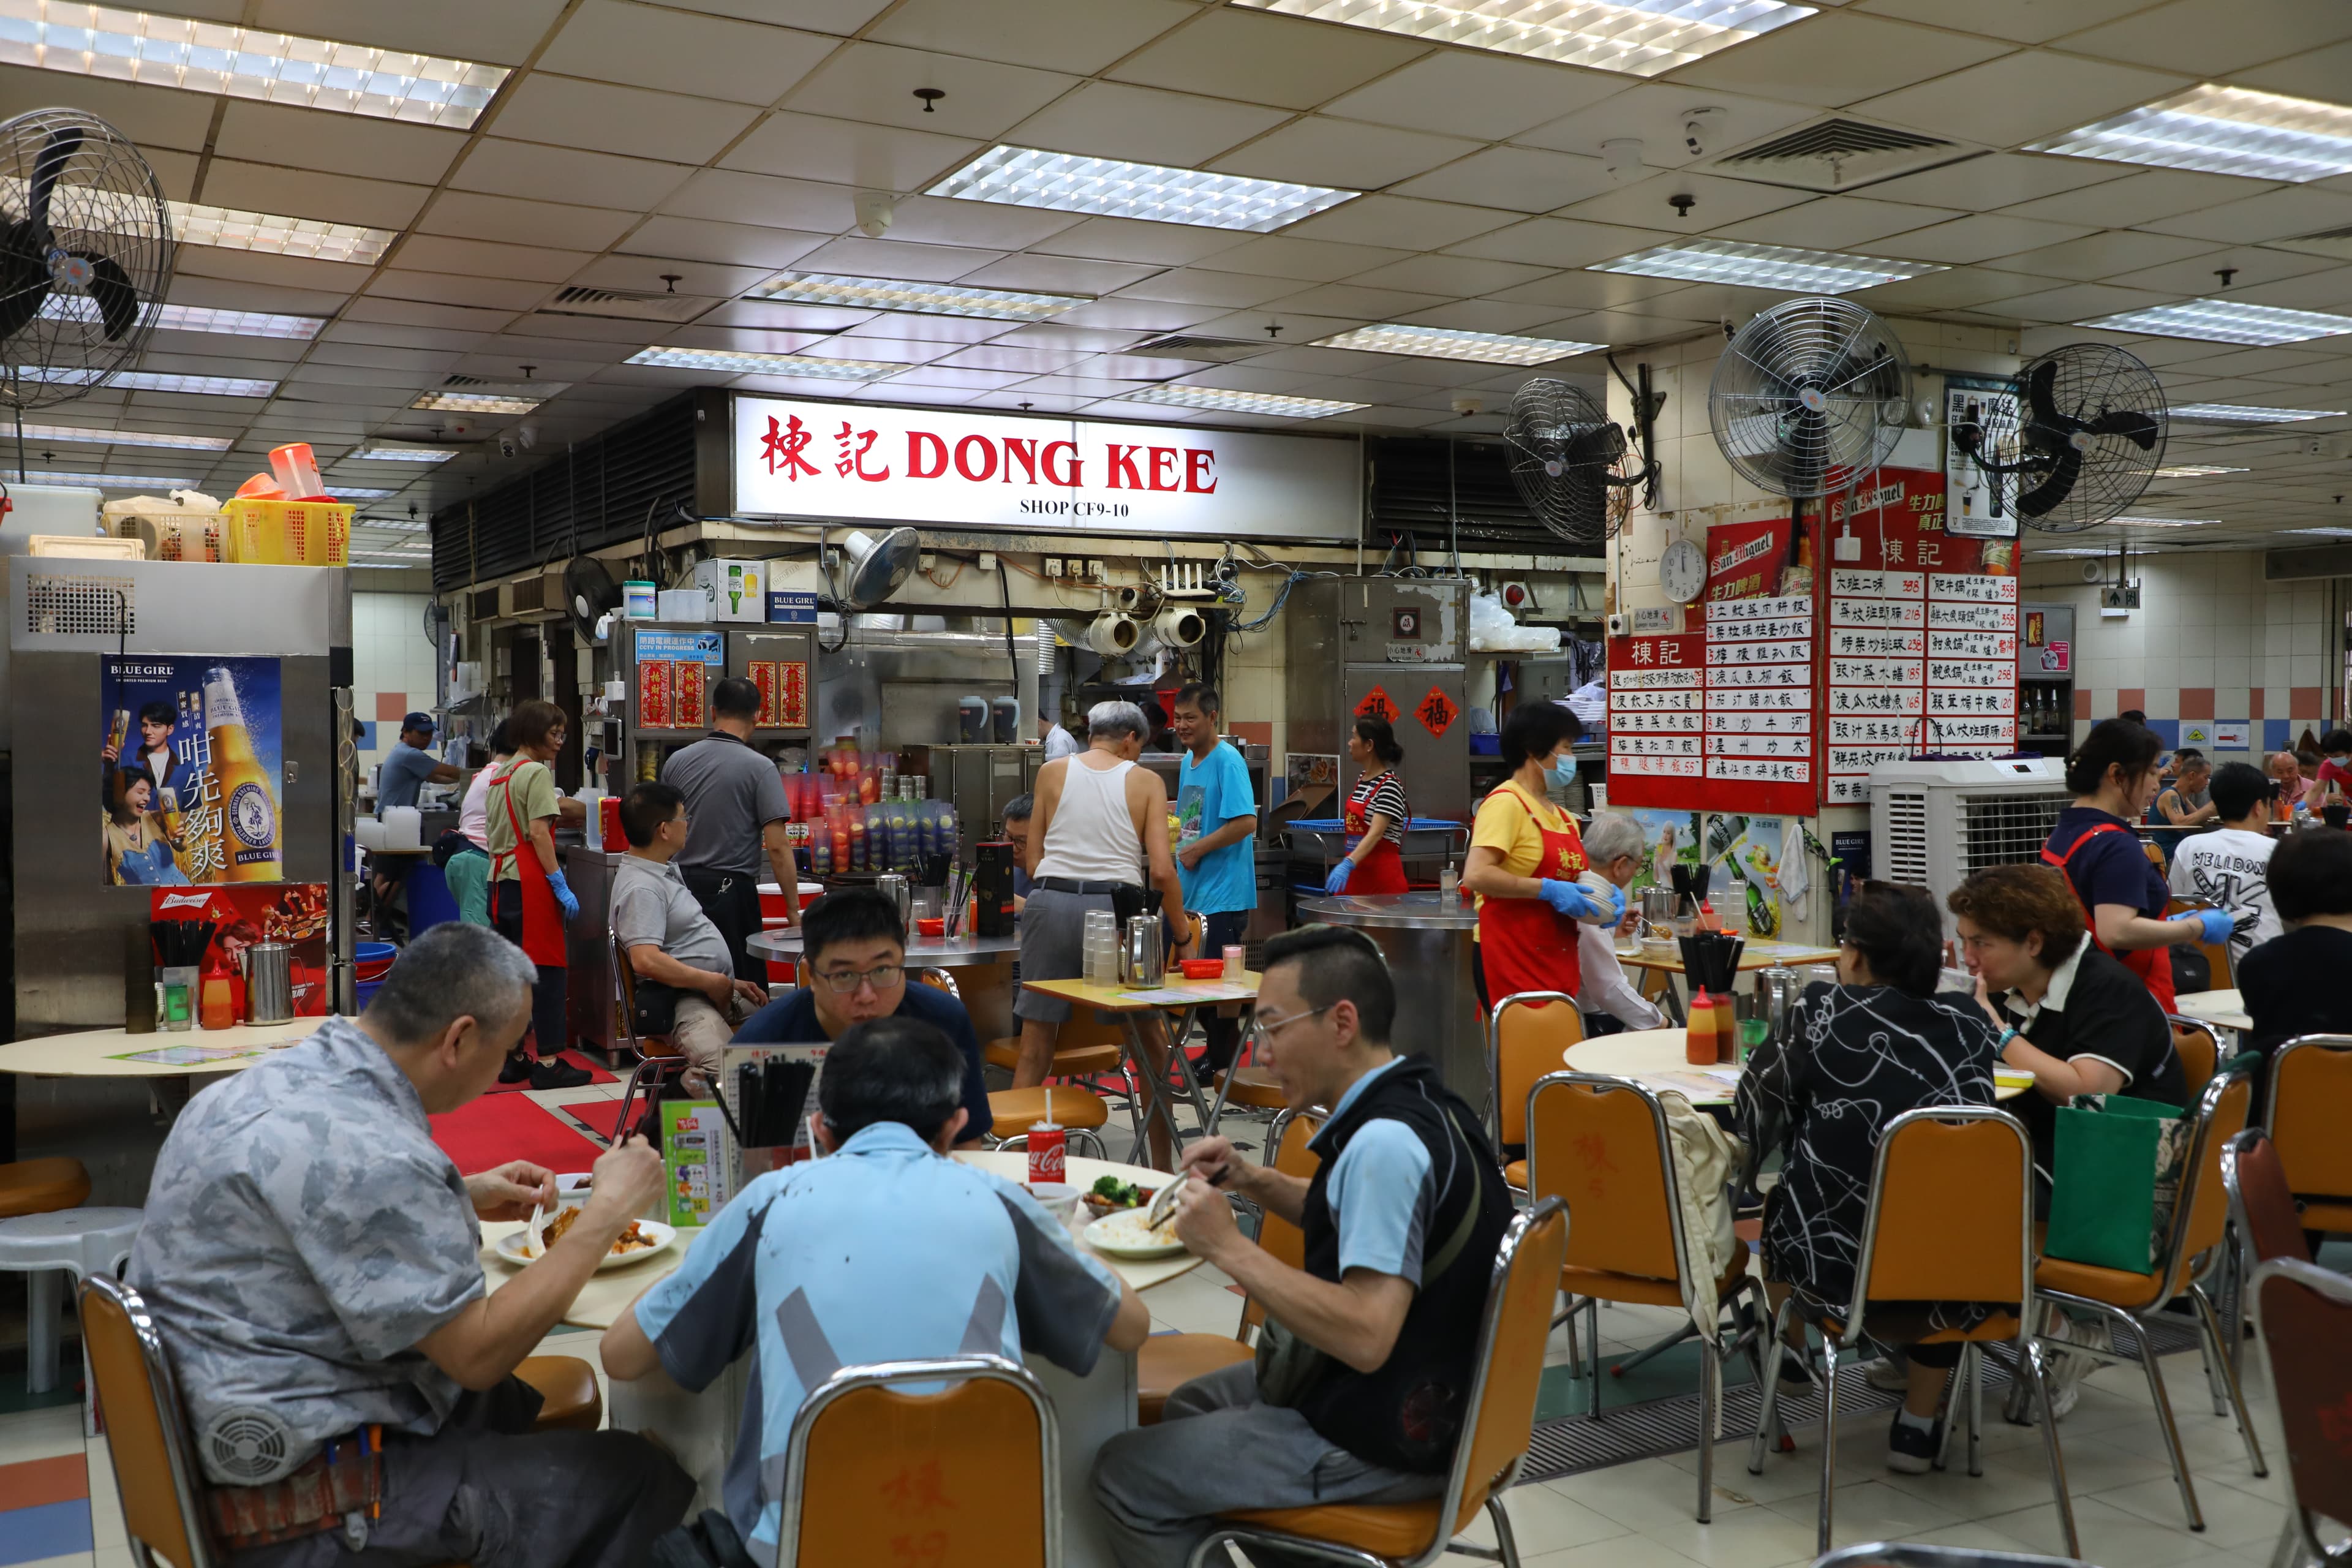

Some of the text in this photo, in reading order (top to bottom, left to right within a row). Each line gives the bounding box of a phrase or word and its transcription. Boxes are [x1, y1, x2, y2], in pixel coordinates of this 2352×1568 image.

[760, 414, 1218, 494] 棟記 DONG KEE
[1020, 499, 1129, 518] SHOP CF9-10
[1734, 530, 1771, 564] Miguel
[1879, 538, 1943, 565] 棟記
[2001, 584, 2015, 598] 358
[1904, 609, 1921, 620] 218
[2002, 614, 2015, 626] 358
[1907, 638, 1922, 651] 238
[1631, 641, 1683, 665] 棟記
[143, 666, 173, 675] GIRL
[1906, 668, 1920, 679] 185
[1997, 669, 2011, 680] 258
[1906, 696, 1920, 708] 168
[2000, 698, 2011, 709] 120
[1423, 697, 1448, 728] 福
[2001, 726, 2013, 737] 218
[1834, 782, 1870, 798] 梅菜
[178, 730, 228, 880] 咁先夠爽
[238, 852, 262, 862] BLUE
[1557, 848, 1585, 870] 棟記
[165, 894, 206, 905] Budweiser
